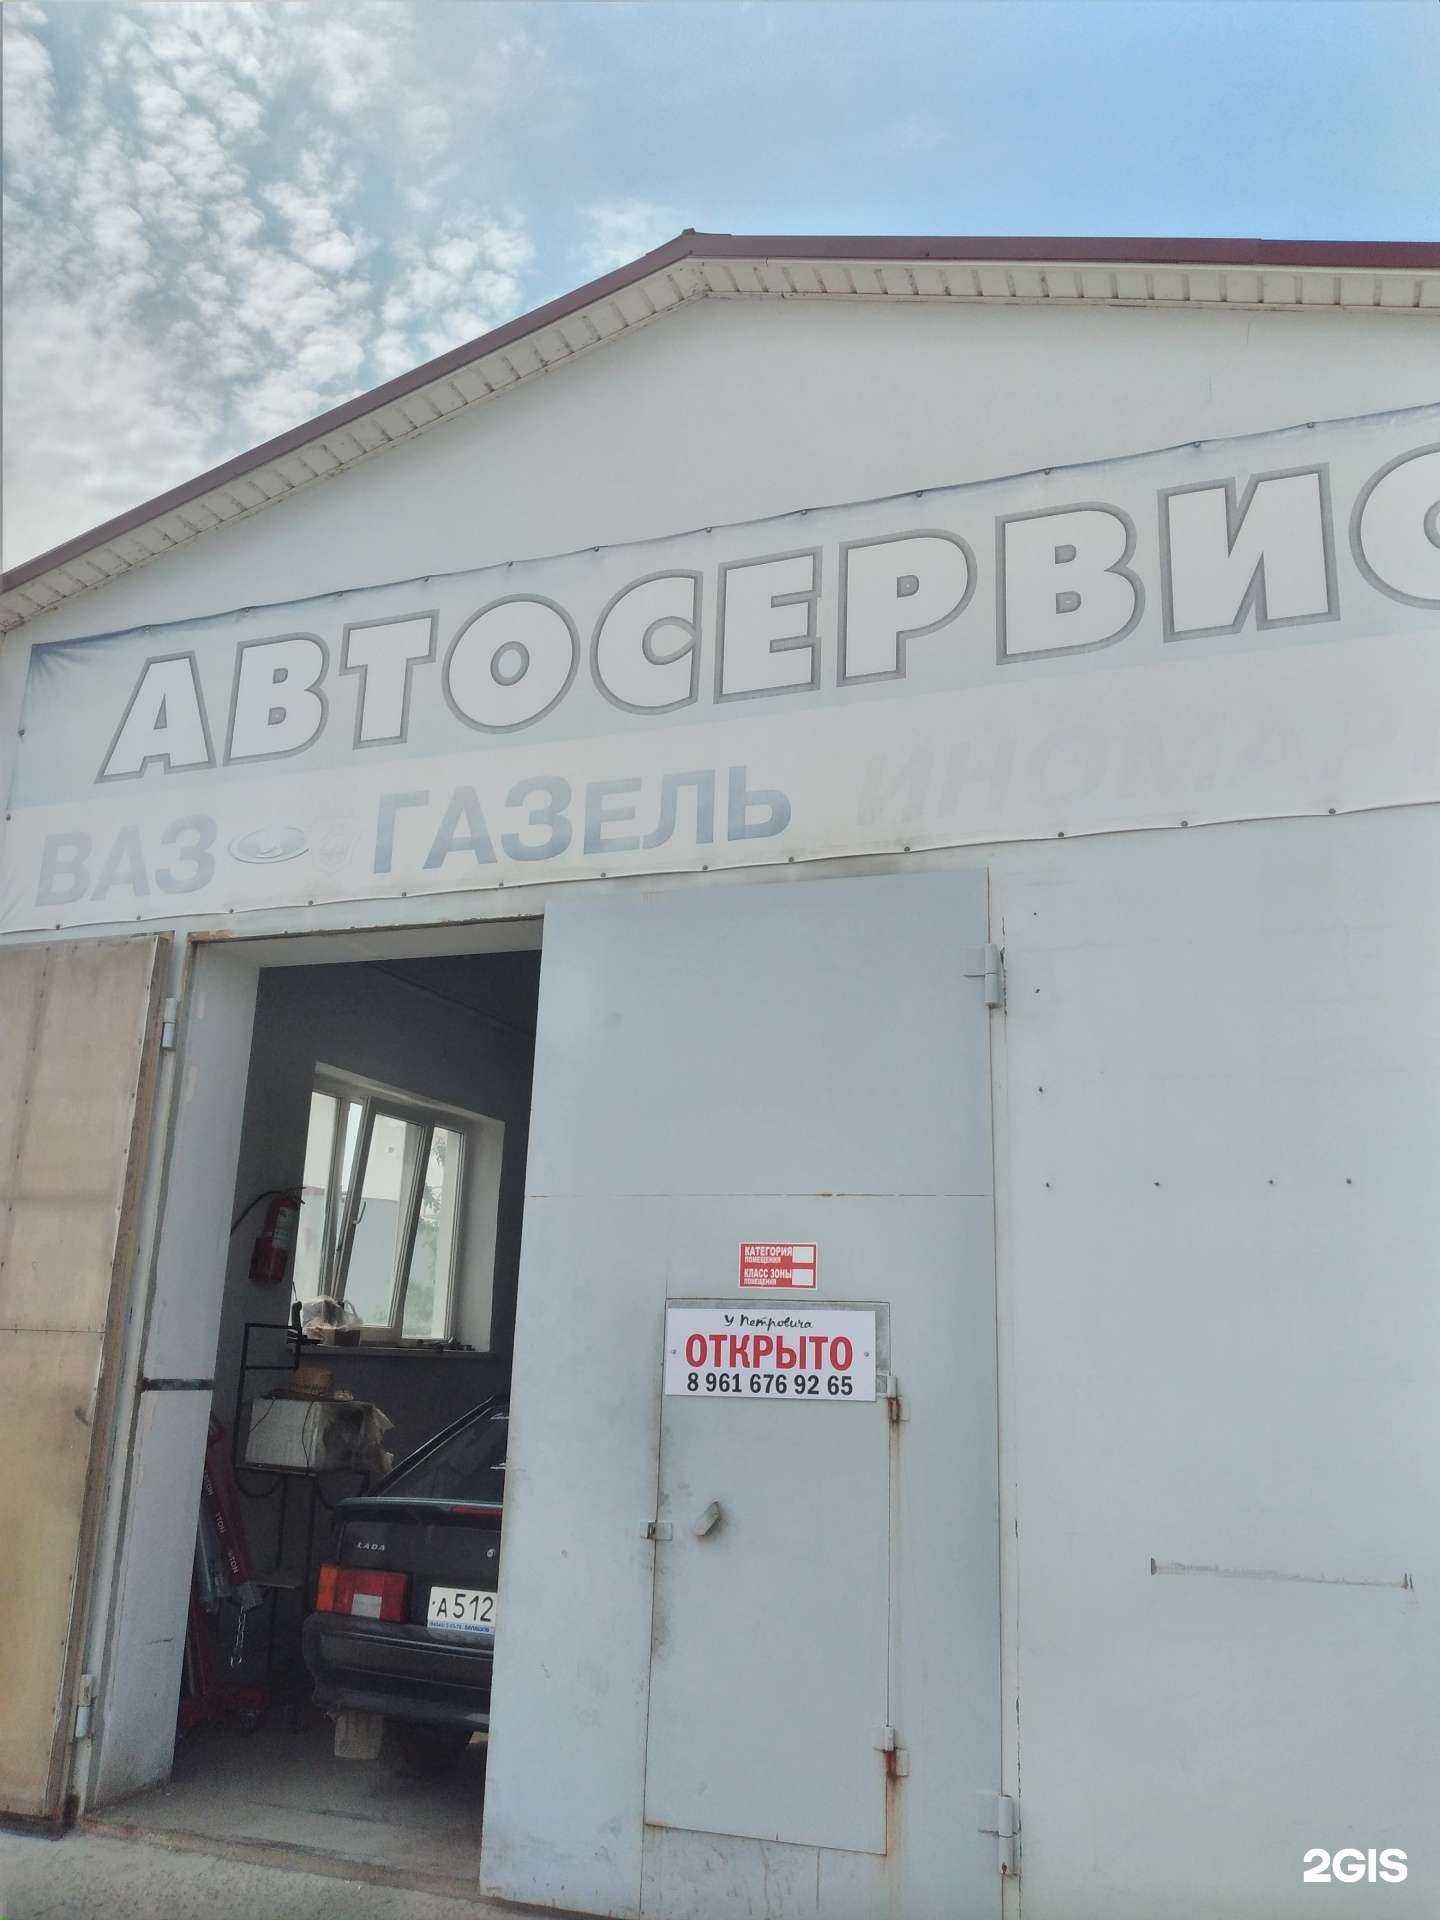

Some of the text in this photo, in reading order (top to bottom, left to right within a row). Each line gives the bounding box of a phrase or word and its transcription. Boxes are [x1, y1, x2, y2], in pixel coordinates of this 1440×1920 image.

[95, 442, 1440, 784] АВТОСЕРВИС
[35, 815, 218, 906] ВАЗ
[373, 765, 792, 874] ГАЗЕЛЬ
[744, 1246, 793, 1257] КАТЕГОРИЯ
[744, 1268, 792, 1279] КЛАСС ЗОНЫ
[685, 1333, 853, 1371] ОТКРЫТО
[687, 1372, 853, 1395] 8 961 676 92 65
